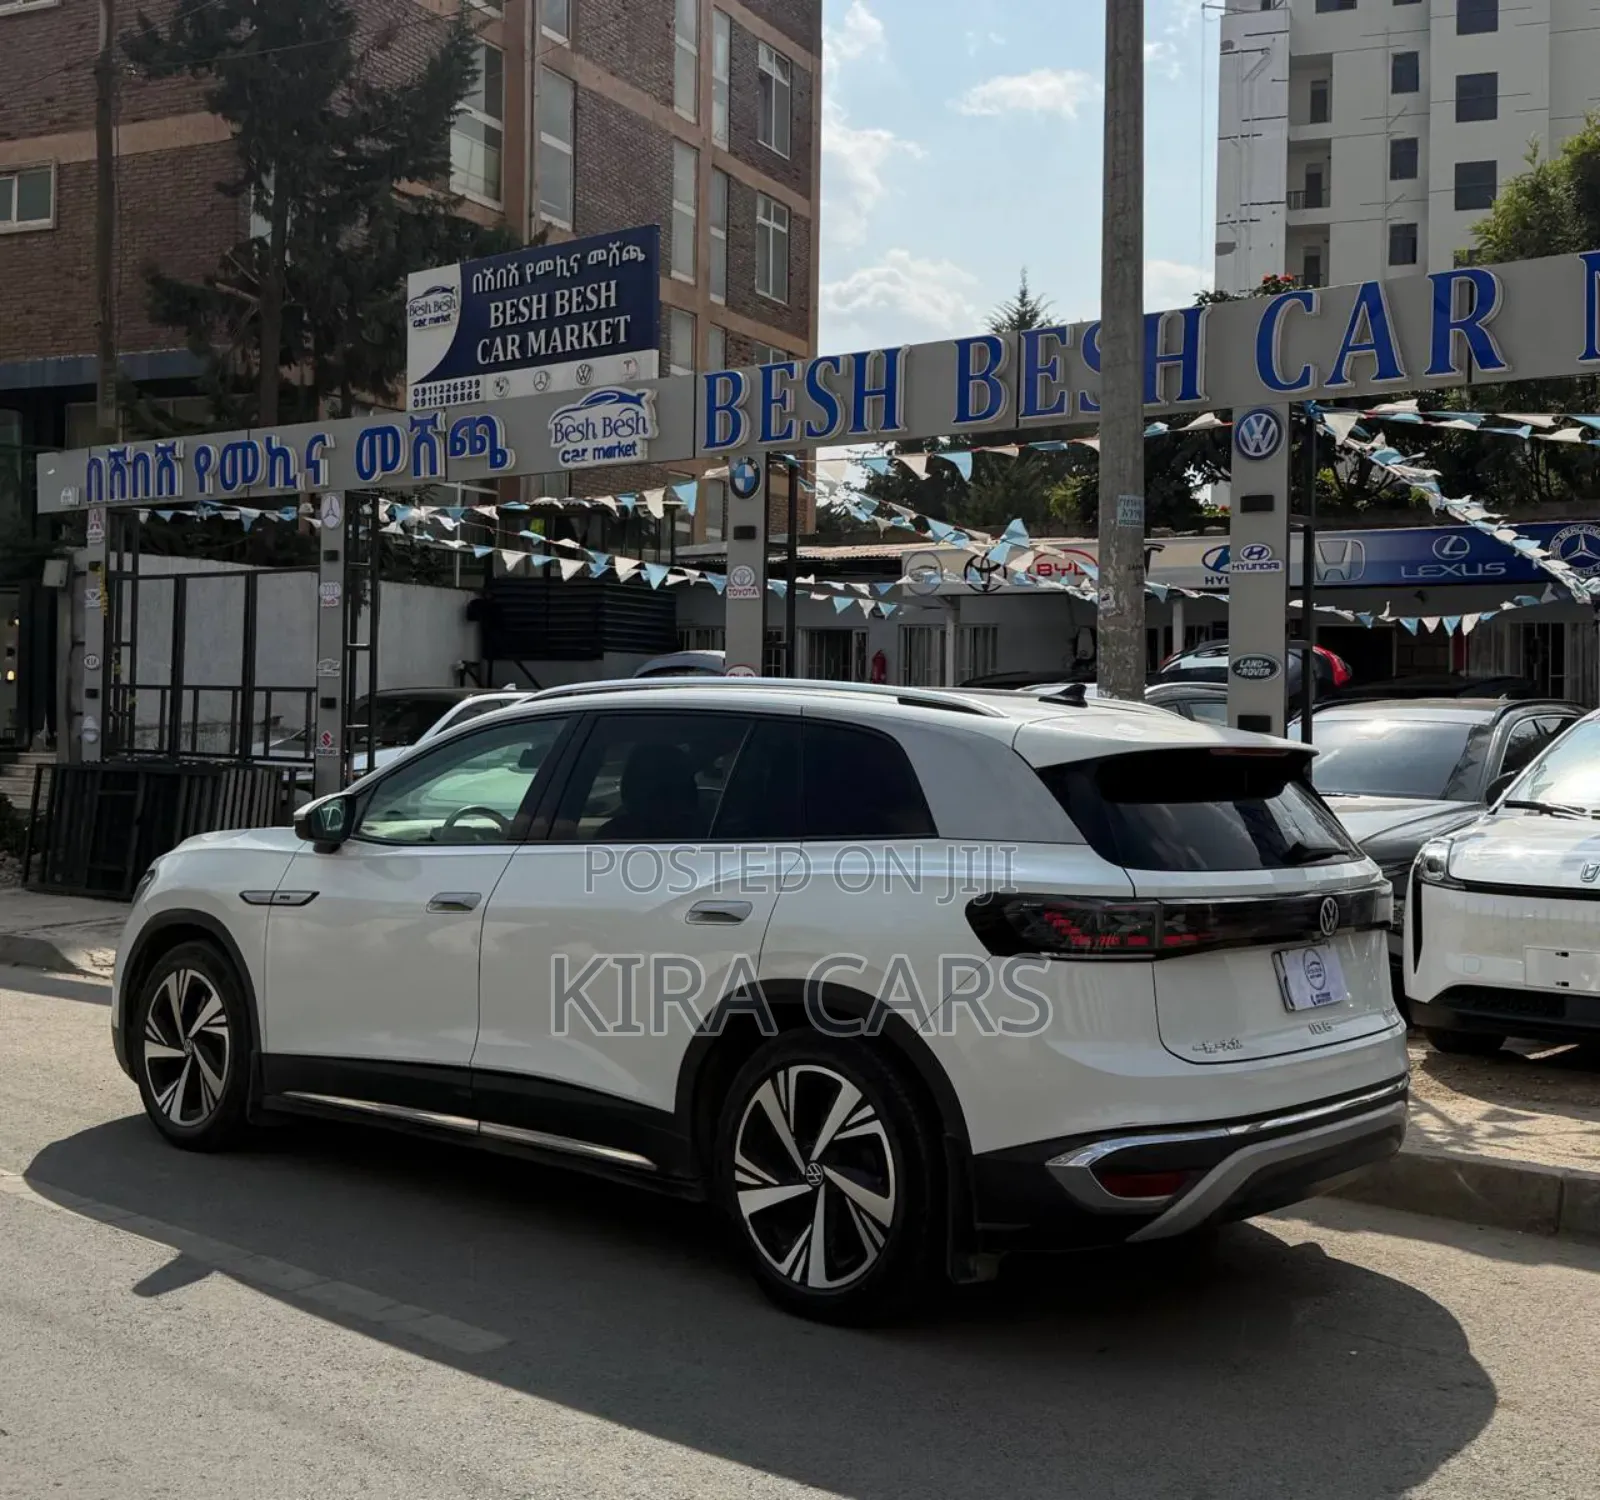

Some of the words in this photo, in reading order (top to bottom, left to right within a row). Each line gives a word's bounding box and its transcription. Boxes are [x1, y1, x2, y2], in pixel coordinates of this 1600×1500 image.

[525, 252, 581, 285] የመኪና
[408, 302, 431, 316] Besh
[433, 296, 456, 312] Besh
[489, 297, 547, 329] BESH
[554, 280, 617, 317] BESH
[477, 335, 521, 365] CAR
[528, 315, 631, 358] MARKET
[702, 343, 910, 450] BESH
[1255, 268, 1512, 394] CAR
[413, 379, 481, 397] 0911226539
[413, 390, 481, 408] 0911389866
[553, 416, 598, 446] Besh
[601, 409, 649, 438] Besh
[194, 433, 335, 495] የመኪና
[355, 411, 515, 482] መሸጫ
[560, 447, 587, 462] car
[592, 441, 639, 460] market
[1232, 562, 1280, 571] HYUNDAI
[1401, 562, 1506, 578] LEXUS
[728, 588, 757, 597] TOYOTA
[1239, 660, 1263, 668] LAND
[1242, 668, 1271, 676] ROVER
